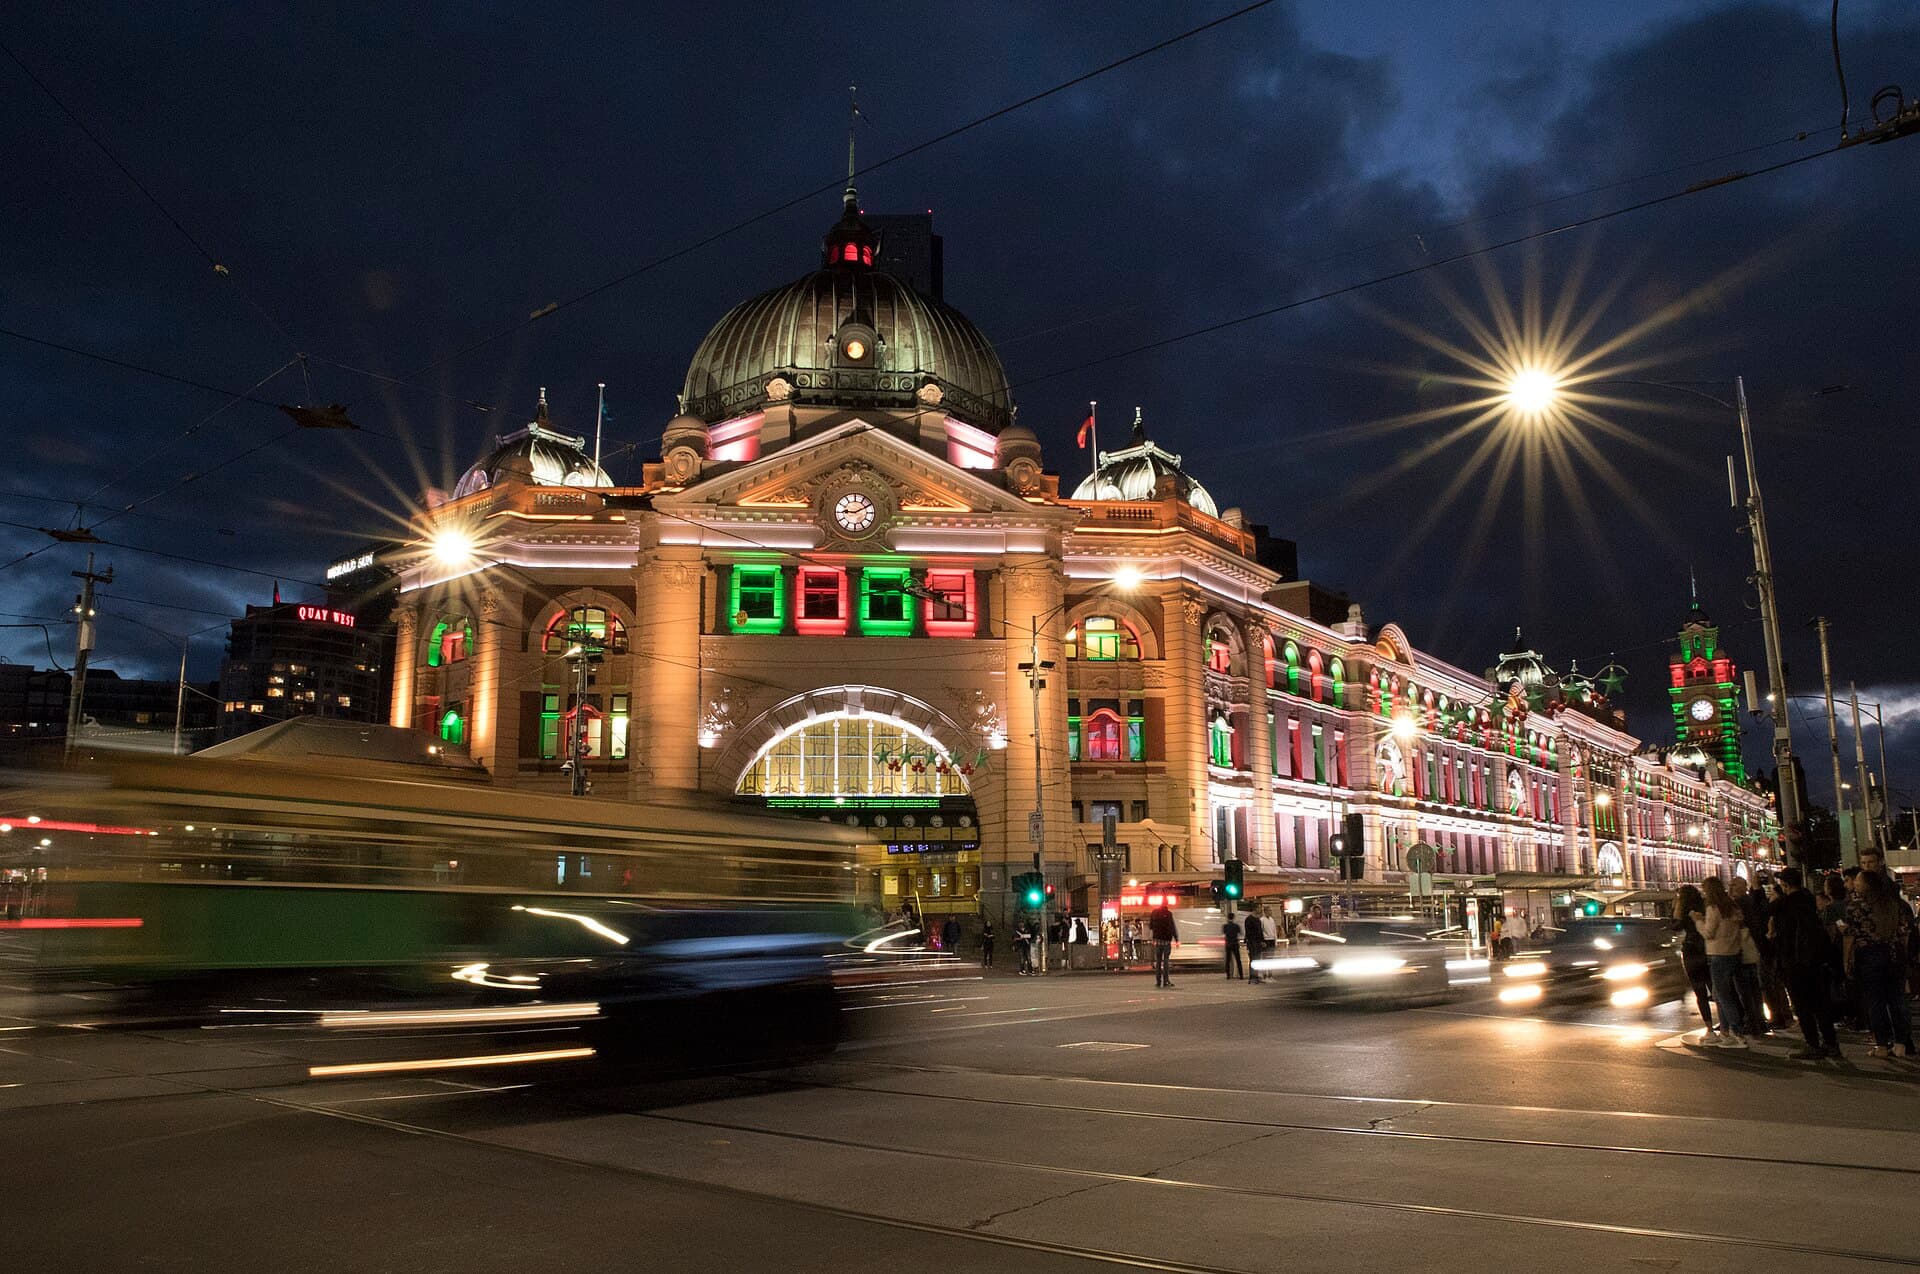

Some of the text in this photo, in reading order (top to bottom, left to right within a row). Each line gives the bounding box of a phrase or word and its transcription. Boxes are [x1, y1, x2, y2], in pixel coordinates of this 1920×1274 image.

[299, 607, 354, 627] QUAY WEST
[1121, 896, 1144, 906] CITY
